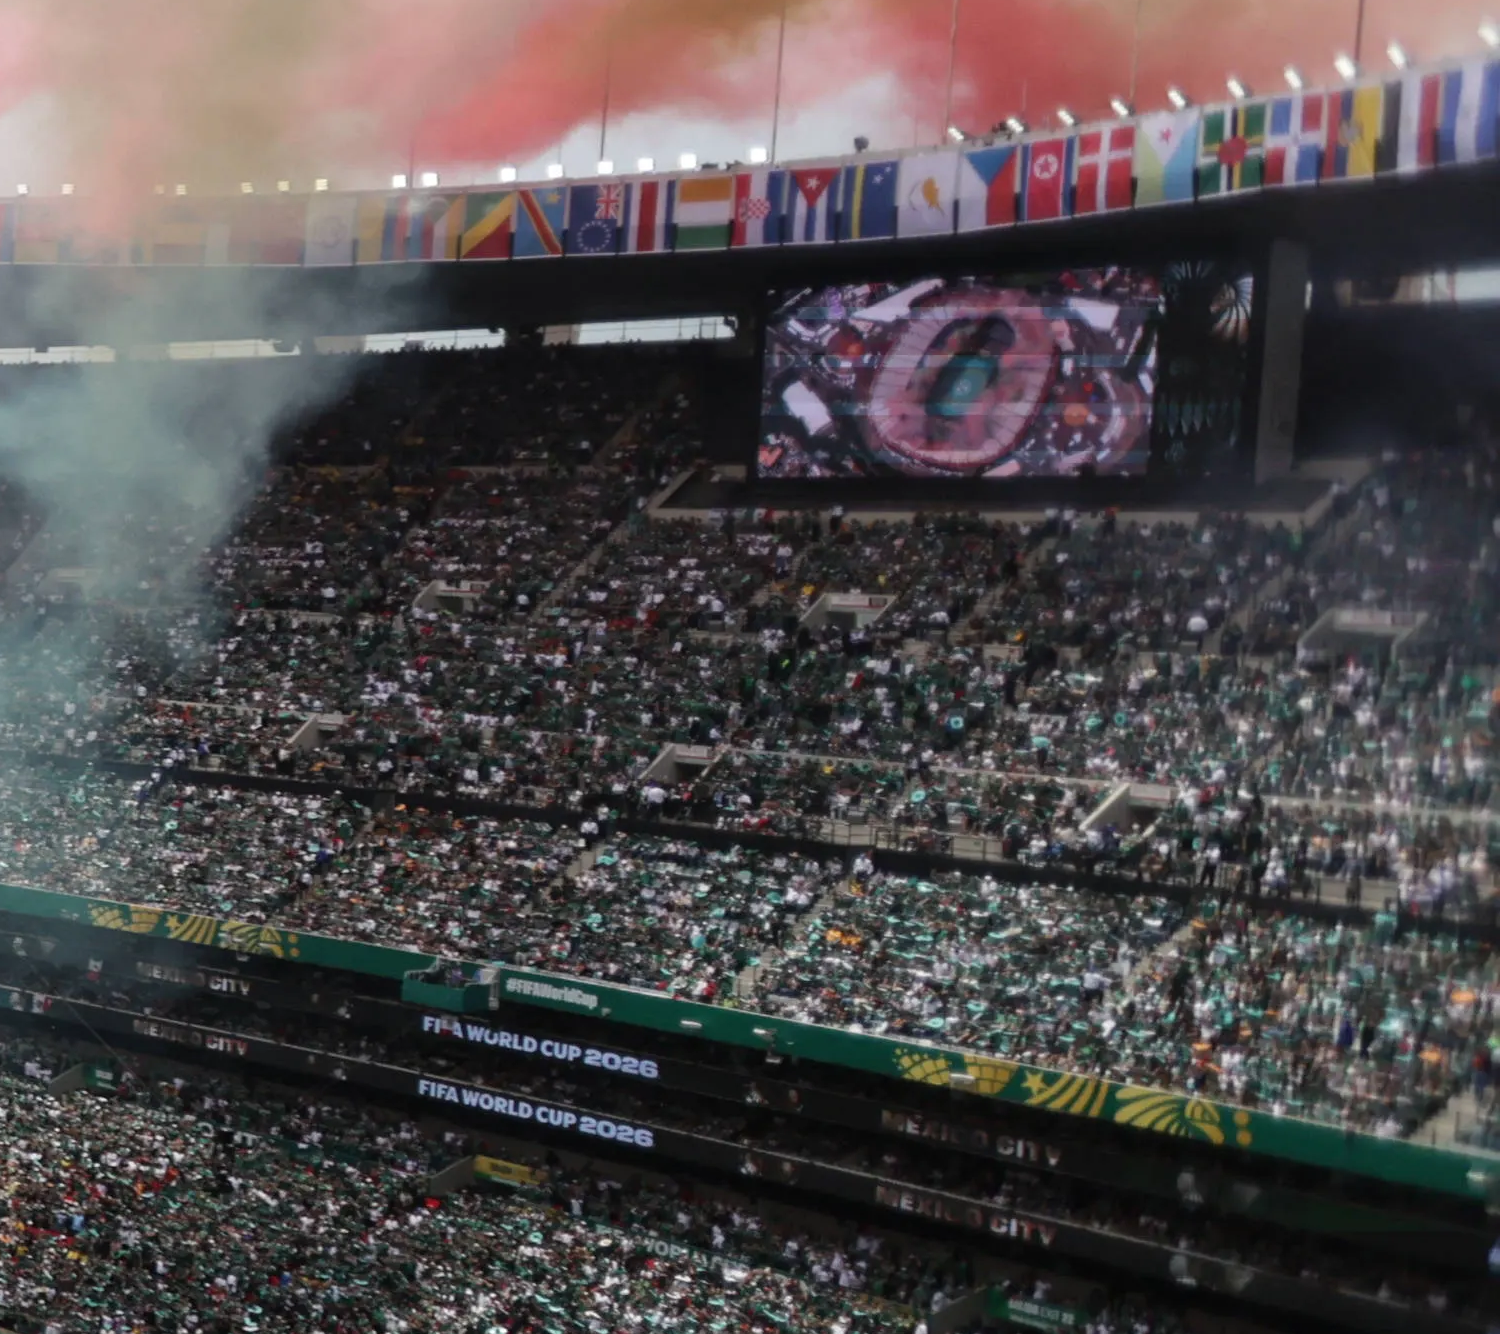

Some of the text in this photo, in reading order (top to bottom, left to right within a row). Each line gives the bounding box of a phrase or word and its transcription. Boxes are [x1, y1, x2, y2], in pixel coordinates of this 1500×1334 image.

[540, 1038, 582, 1062] CUP
[583, 1049, 659, 1079] 2026
[418, 1079, 654, 1147] FIFA WORLD CUP 2026
